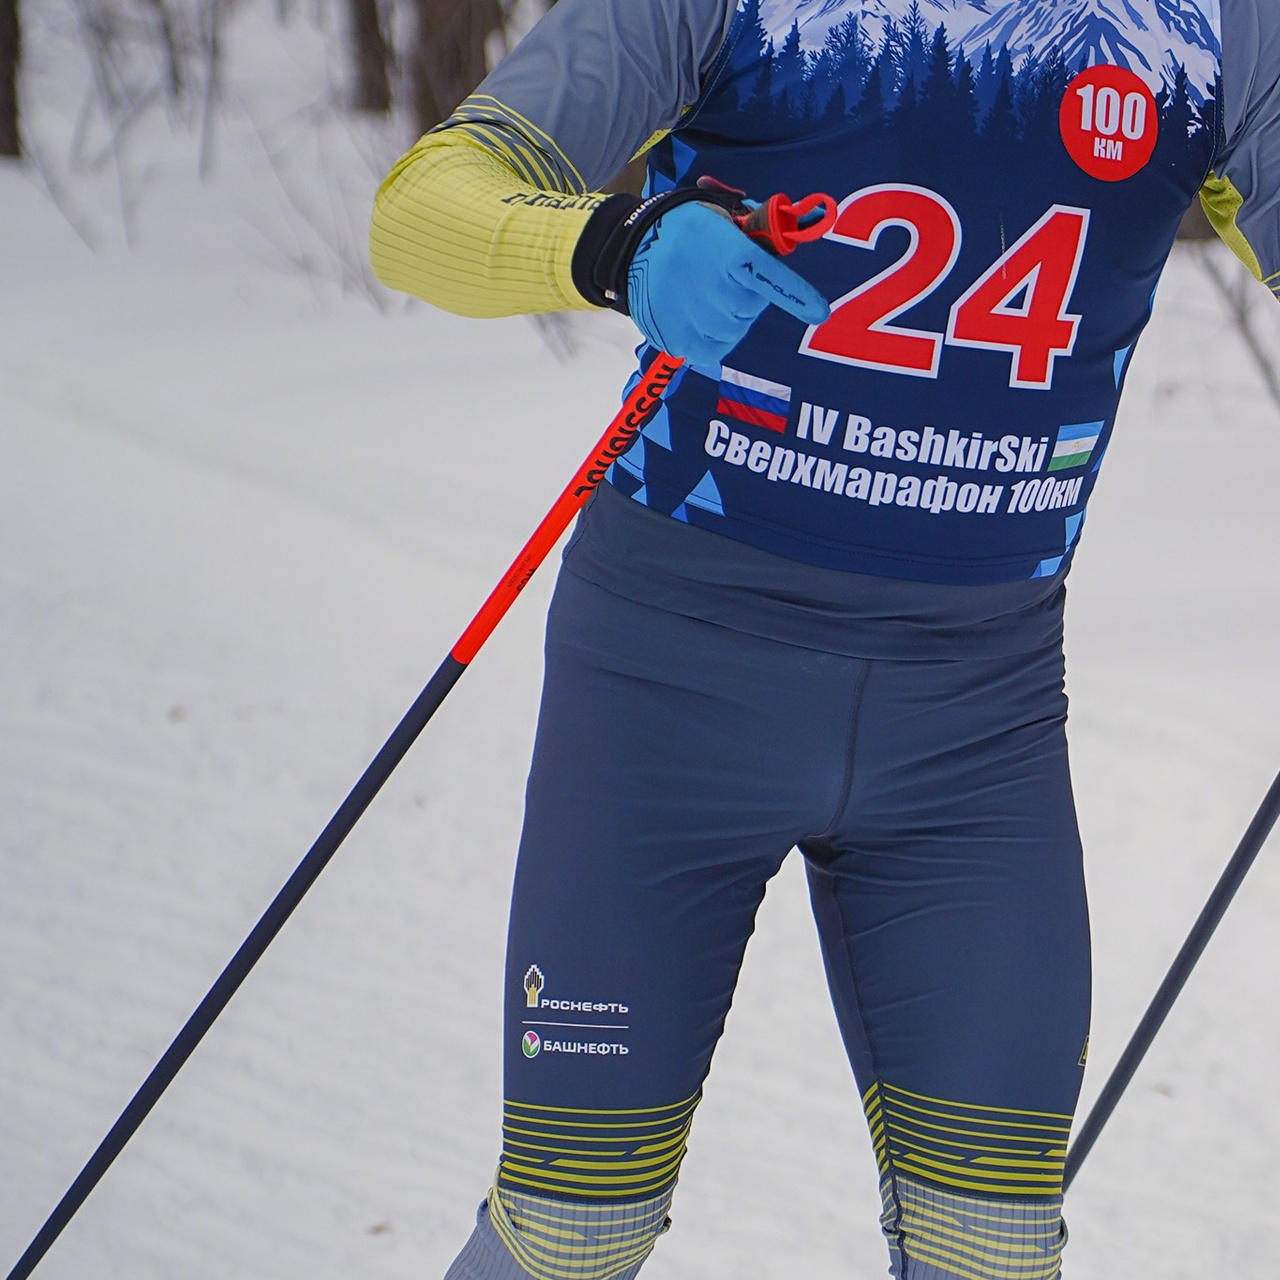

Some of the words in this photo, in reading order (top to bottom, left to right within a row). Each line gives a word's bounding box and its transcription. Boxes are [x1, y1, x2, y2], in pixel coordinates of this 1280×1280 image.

[1075, 85, 1147, 140] 100
[798, 182, 1091, 390] 24
[704, 419, 1004, 514] Сверхмарафон
[796, 401, 840, 445] IV
[843, 414, 1049, 473] BashkirSki
[541, 999, 629, 1014] РОСНЕФТЬ
[543, 1040, 629, 1055] БАШНЕФТЬ
